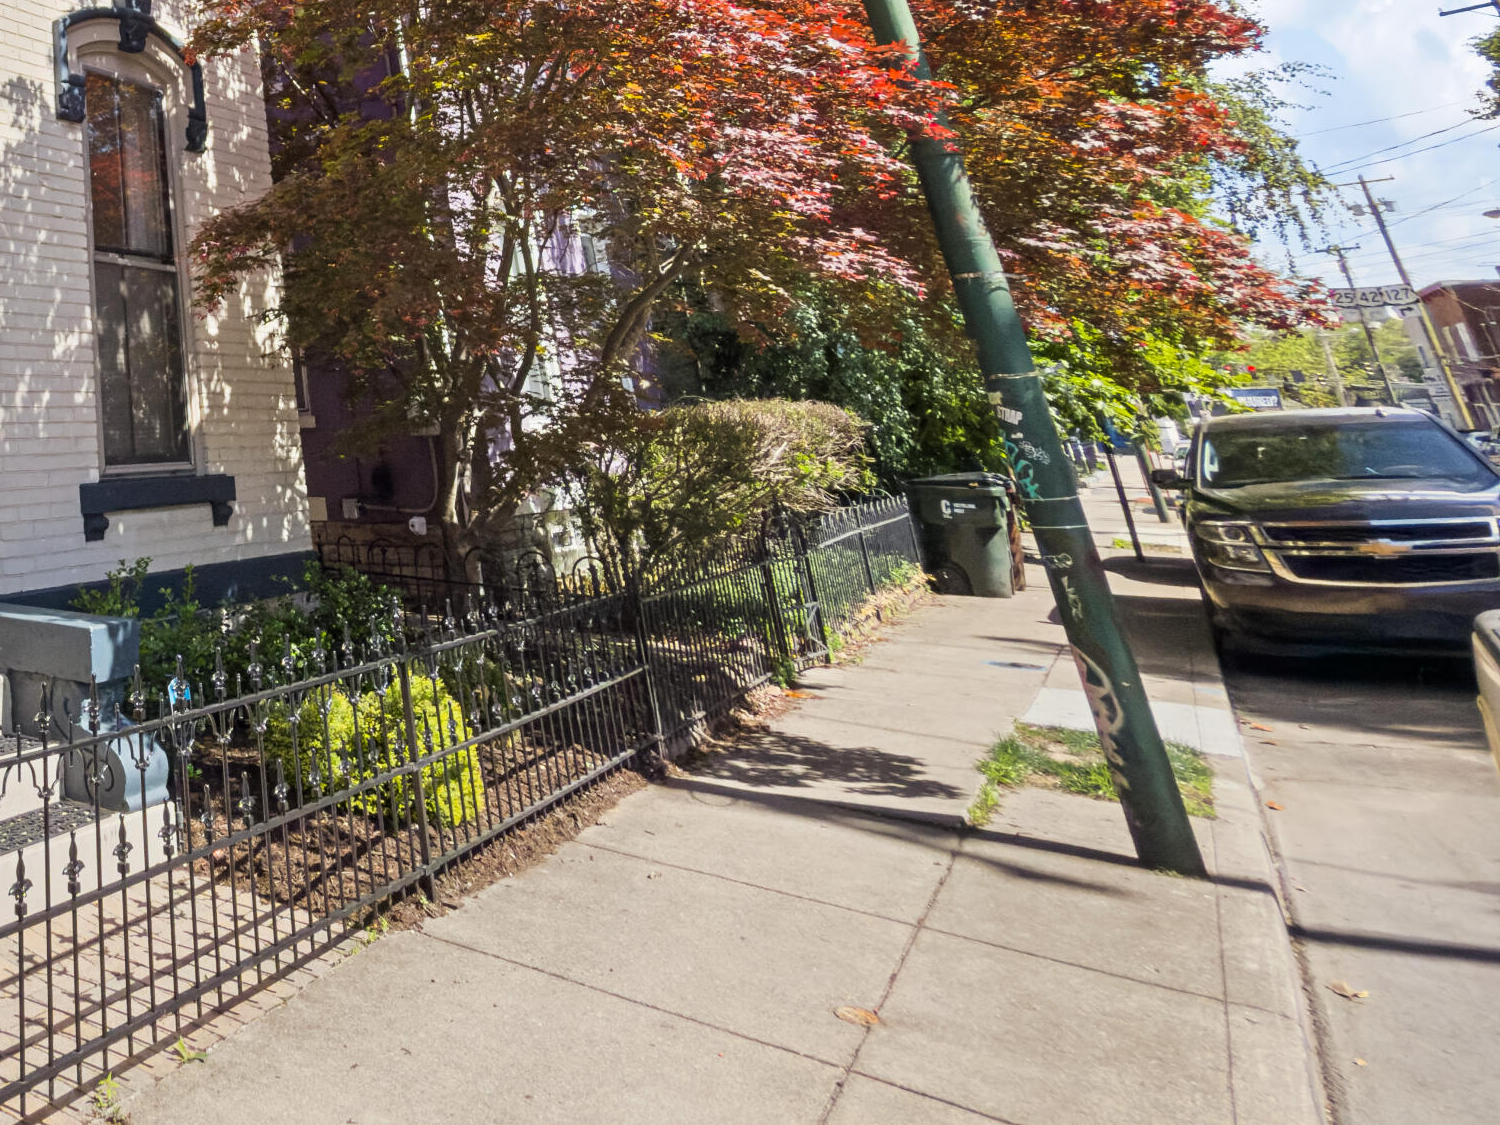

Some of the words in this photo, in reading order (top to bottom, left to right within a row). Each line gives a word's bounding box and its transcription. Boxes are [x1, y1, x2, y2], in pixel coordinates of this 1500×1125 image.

[1335, 292, 1354, 304] 25
[1360, 291, 1380, 303] 42
[1385, 287, 1409, 301] 127
